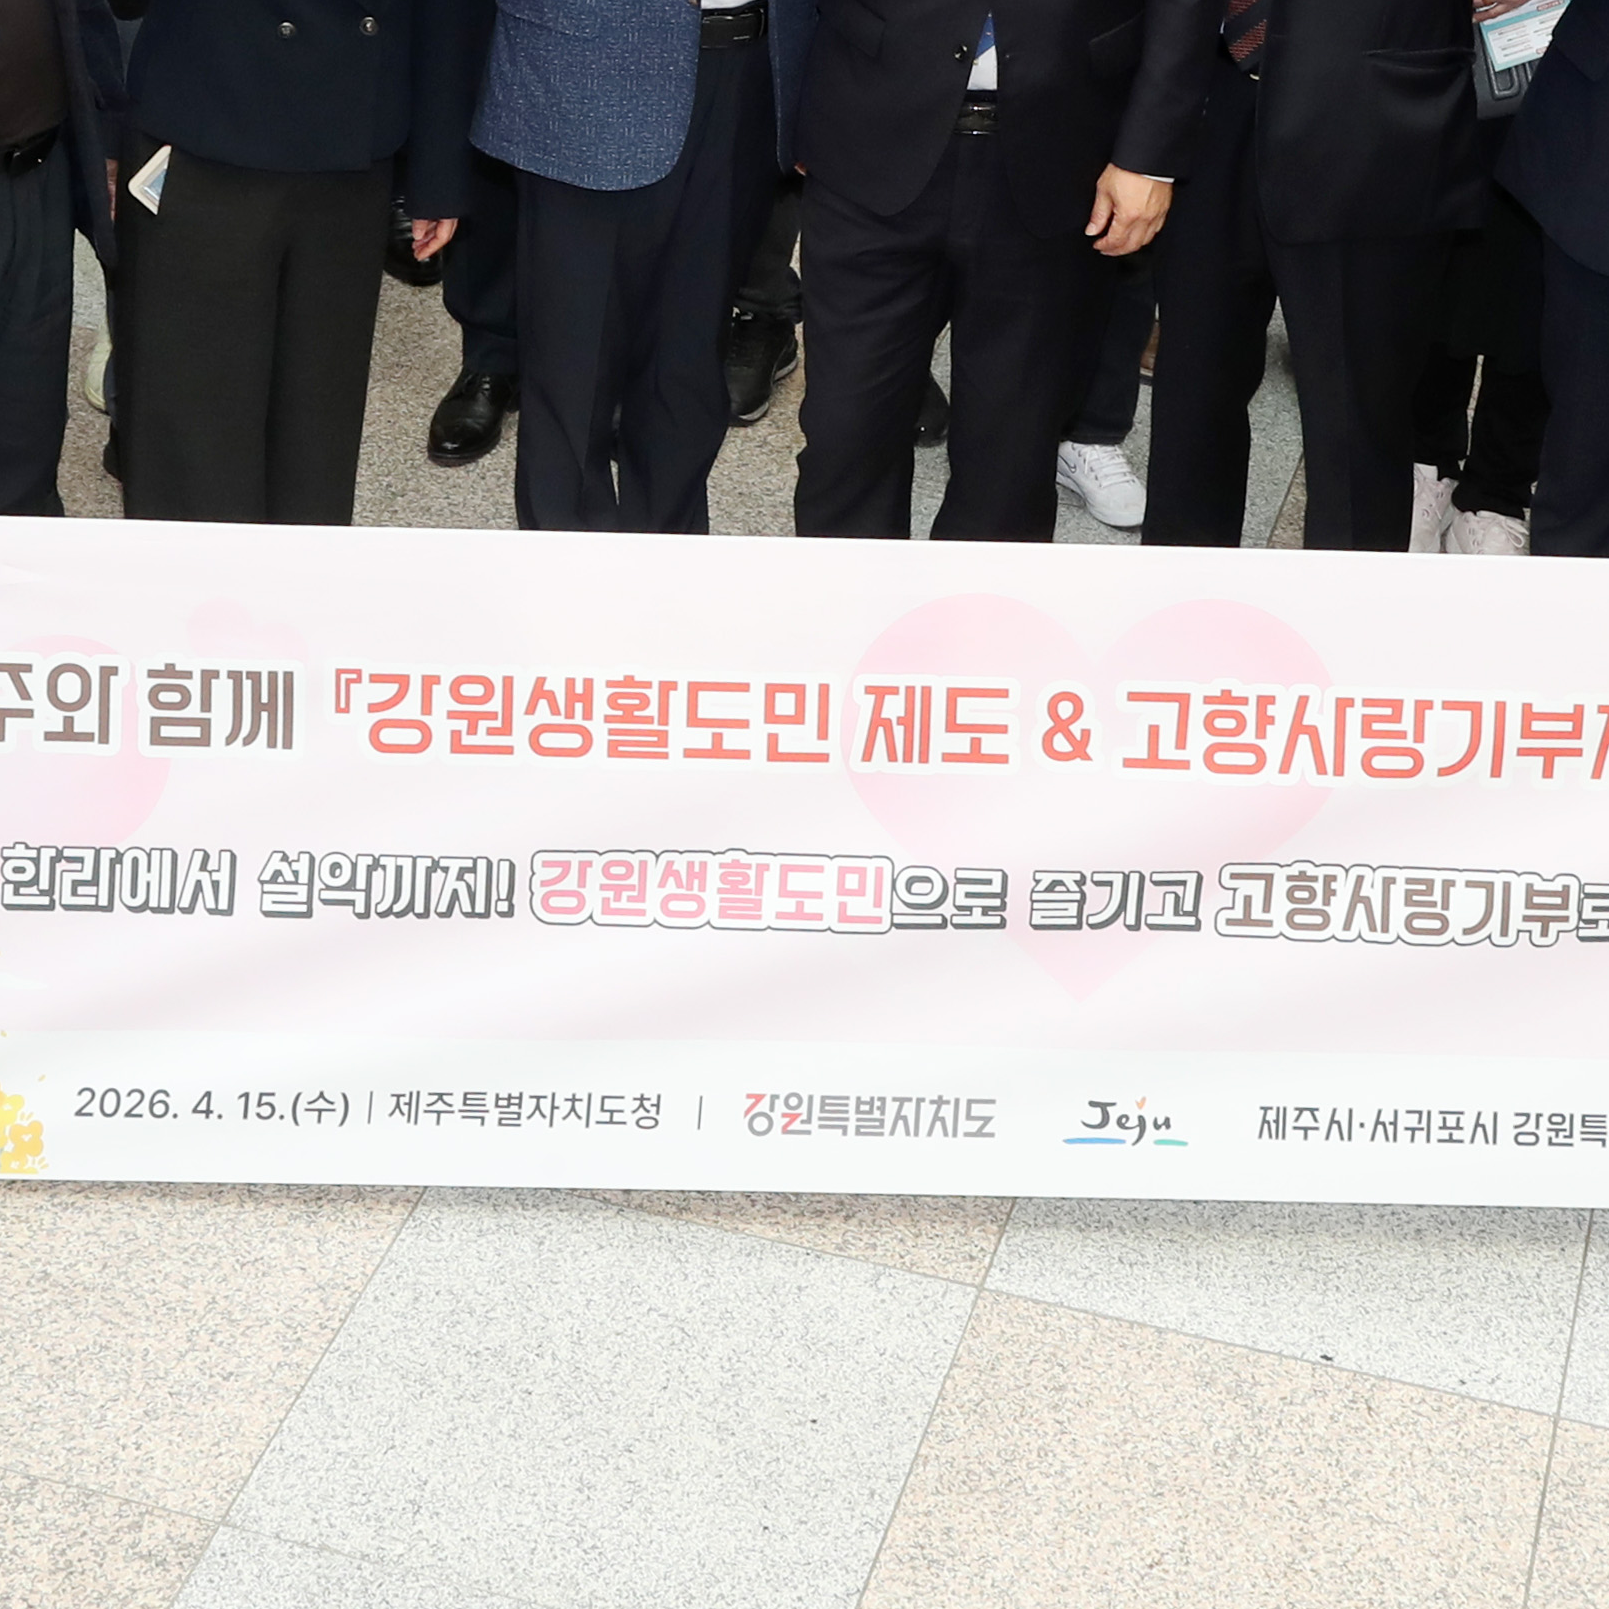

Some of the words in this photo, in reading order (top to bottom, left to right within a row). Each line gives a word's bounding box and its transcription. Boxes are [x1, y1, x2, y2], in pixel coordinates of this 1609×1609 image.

[145, 661, 296, 751] 함께
[335, 667, 831, 764] 『강원생활도민
[859, 684, 1011, 766] 제도
[1041, 690, 1093, 762] &
[0, 841, 239, 917] 한라에서
[256, 850, 517, 921] 설악까지!
[529, 849, 1009, 936] 강원생활도민으로
[1028, 868, 1204, 933] 즐기고
[74, 1086, 180, 1121] 2026.
[191, 1089, 223, 1121] 4.
[238, 1088, 350, 1128] 15.(수)
[388, 1090, 663, 1131] 제주특별자치도청
[744, 1092, 997, 1139] 강원특별자치도
[1078, 1096, 1174, 1147] Jeju
[1257, 1105, 1499, 1147] 제주시·서귀포시
